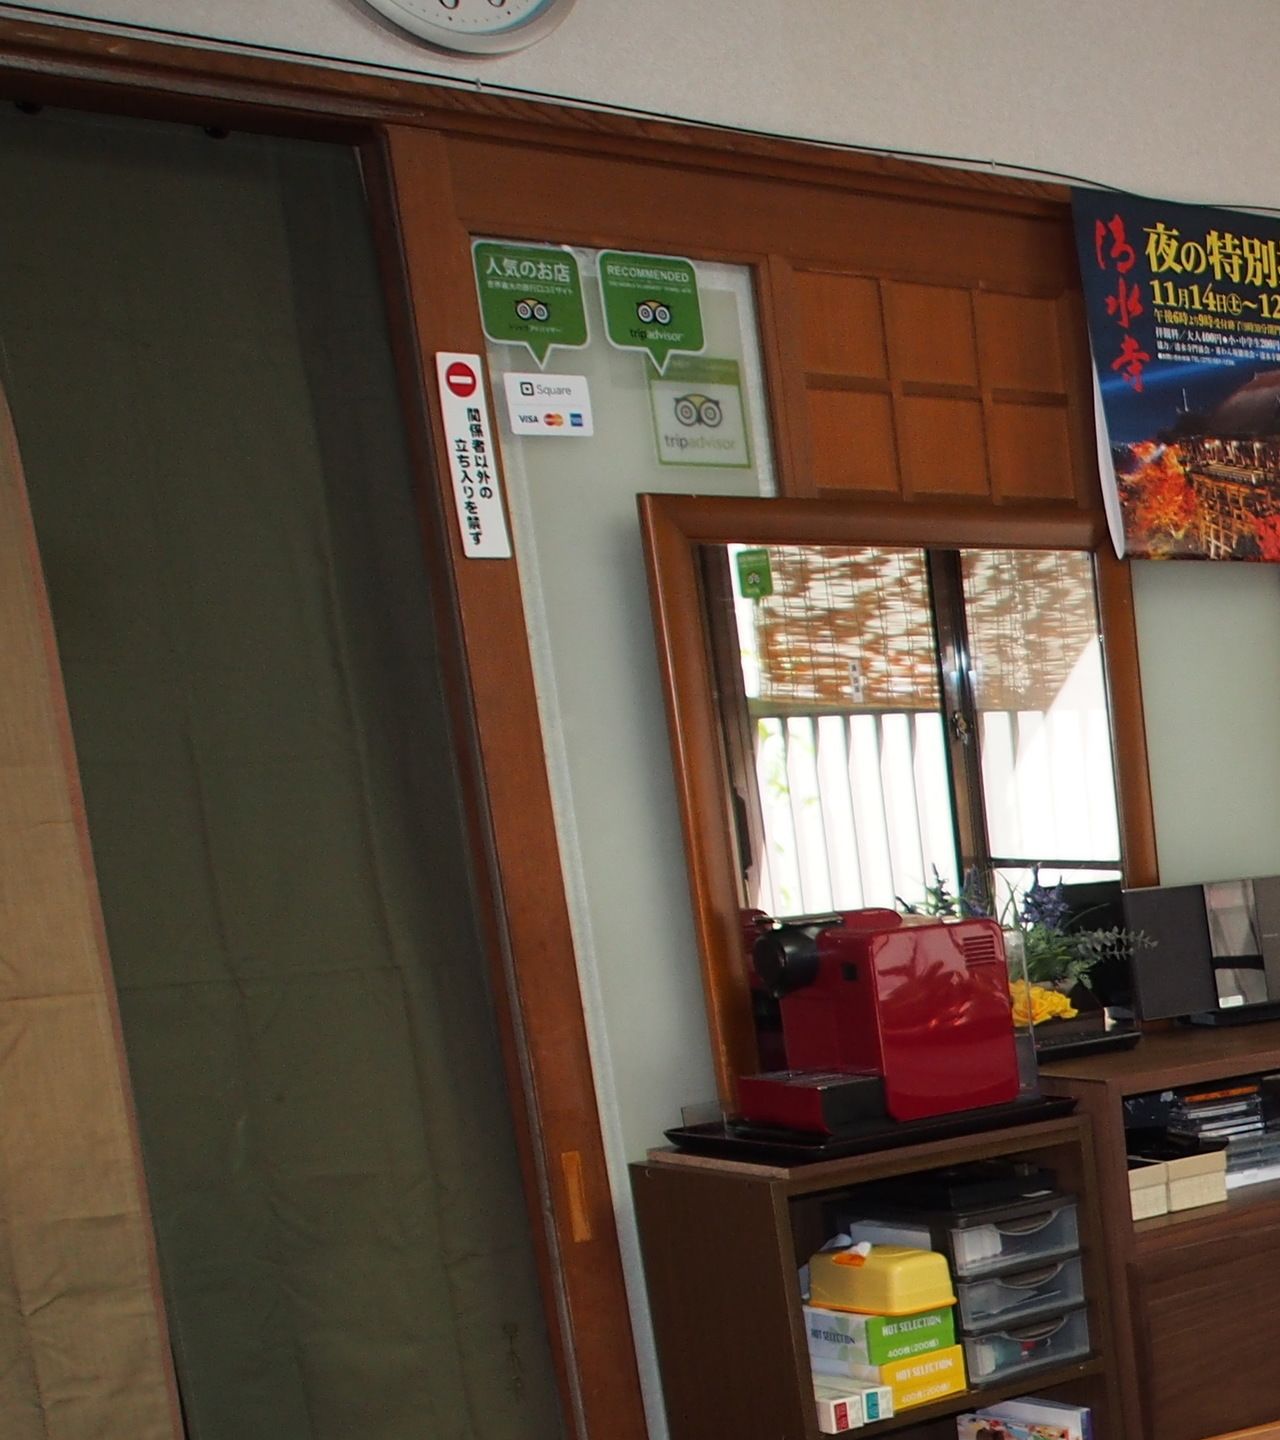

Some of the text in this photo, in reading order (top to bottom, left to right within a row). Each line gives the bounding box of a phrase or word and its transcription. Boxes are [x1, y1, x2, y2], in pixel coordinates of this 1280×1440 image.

[486, 258, 571, 283] 人気のお店
[607, 264, 690, 283] RECOMMENDED
[630, 327, 681, 342] tripadvisor
[537, 385, 572, 396] Square
[519, 415, 539, 423] VISA
[664, 433, 736, 452] tripadvisor
[467, 408, 493, 500] 関係者以外の
[455, 439, 483, 546] 立ち入りを禁ず
[882, 1316, 942, 1337] HOT SELECTION
[822, 1331, 855, 1344] SELECTION
[913, 1359, 953, 1377] SELECTION
